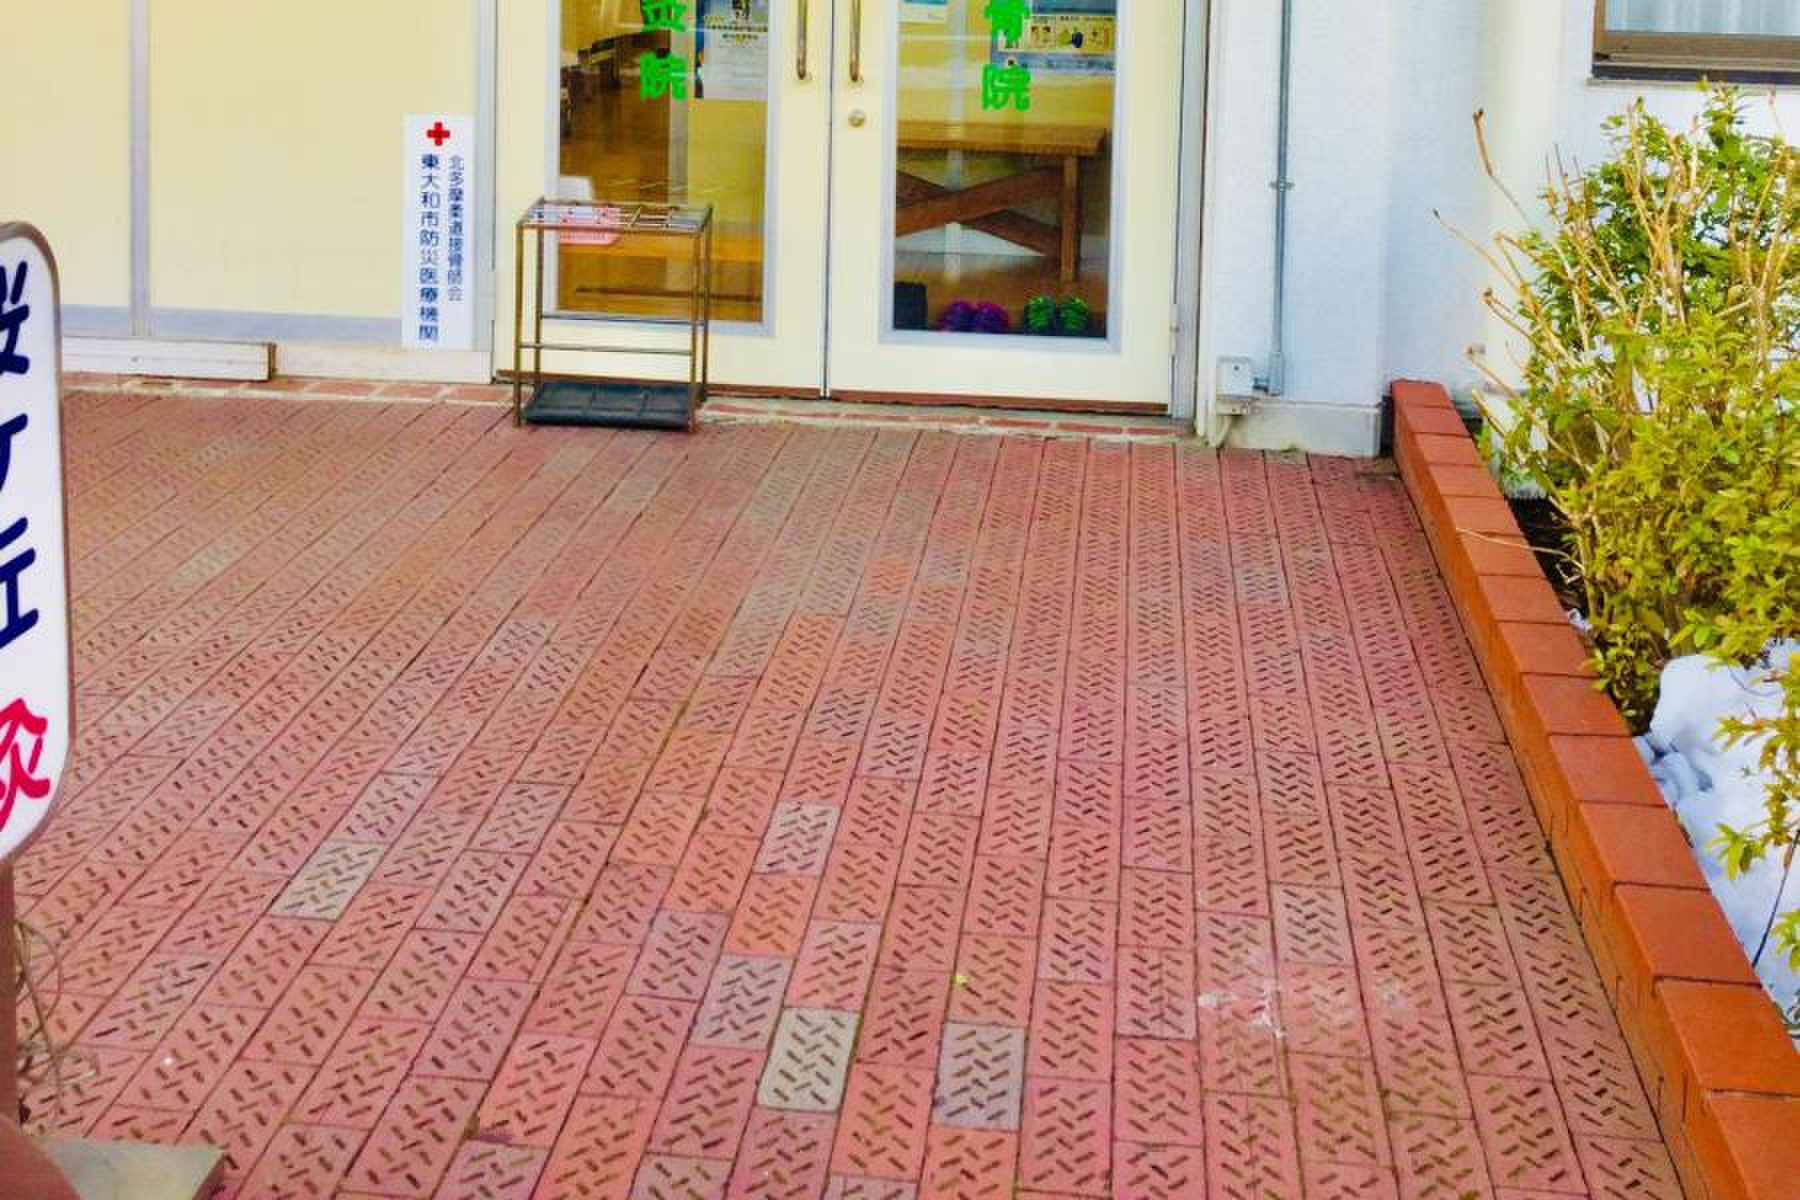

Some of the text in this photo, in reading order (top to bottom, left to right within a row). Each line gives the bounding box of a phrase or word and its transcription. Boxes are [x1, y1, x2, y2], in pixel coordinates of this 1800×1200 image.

[418, 152, 441, 341] 東大和市防災医療機関
